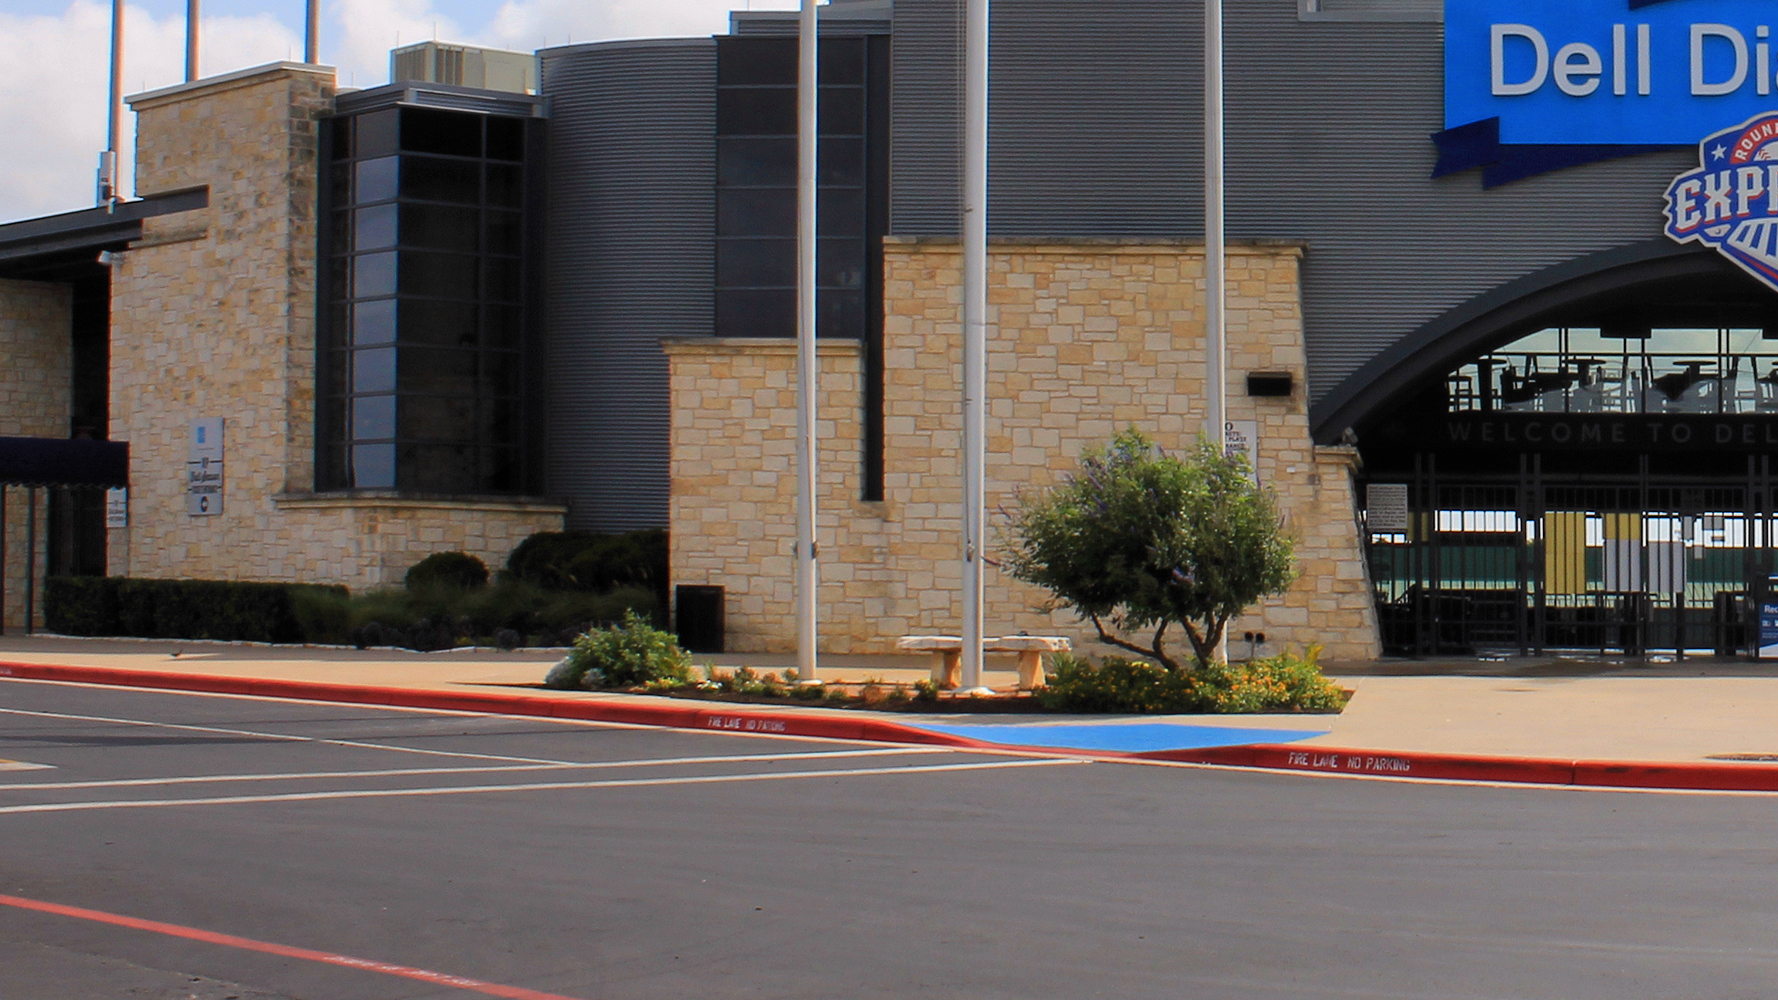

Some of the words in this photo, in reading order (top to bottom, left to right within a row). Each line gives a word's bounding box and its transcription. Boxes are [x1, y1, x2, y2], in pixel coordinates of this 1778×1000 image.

[1490, 22, 1651, 97] Dell
[1448, 422, 1626, 443] WELCOME
[1648, 422, 1692, 444] TO
[707, 716, 722, 727] FIRE
[724, 717, 742, 729] LANE
[745, 719, 756, 730] NO
[1288, 752, 1309, 765] FIRE
[1312, 753, 1338, 768] LANE
[1347, 756, 1362, 769] NO
[1365, 757, 1411, 771] PARKING
